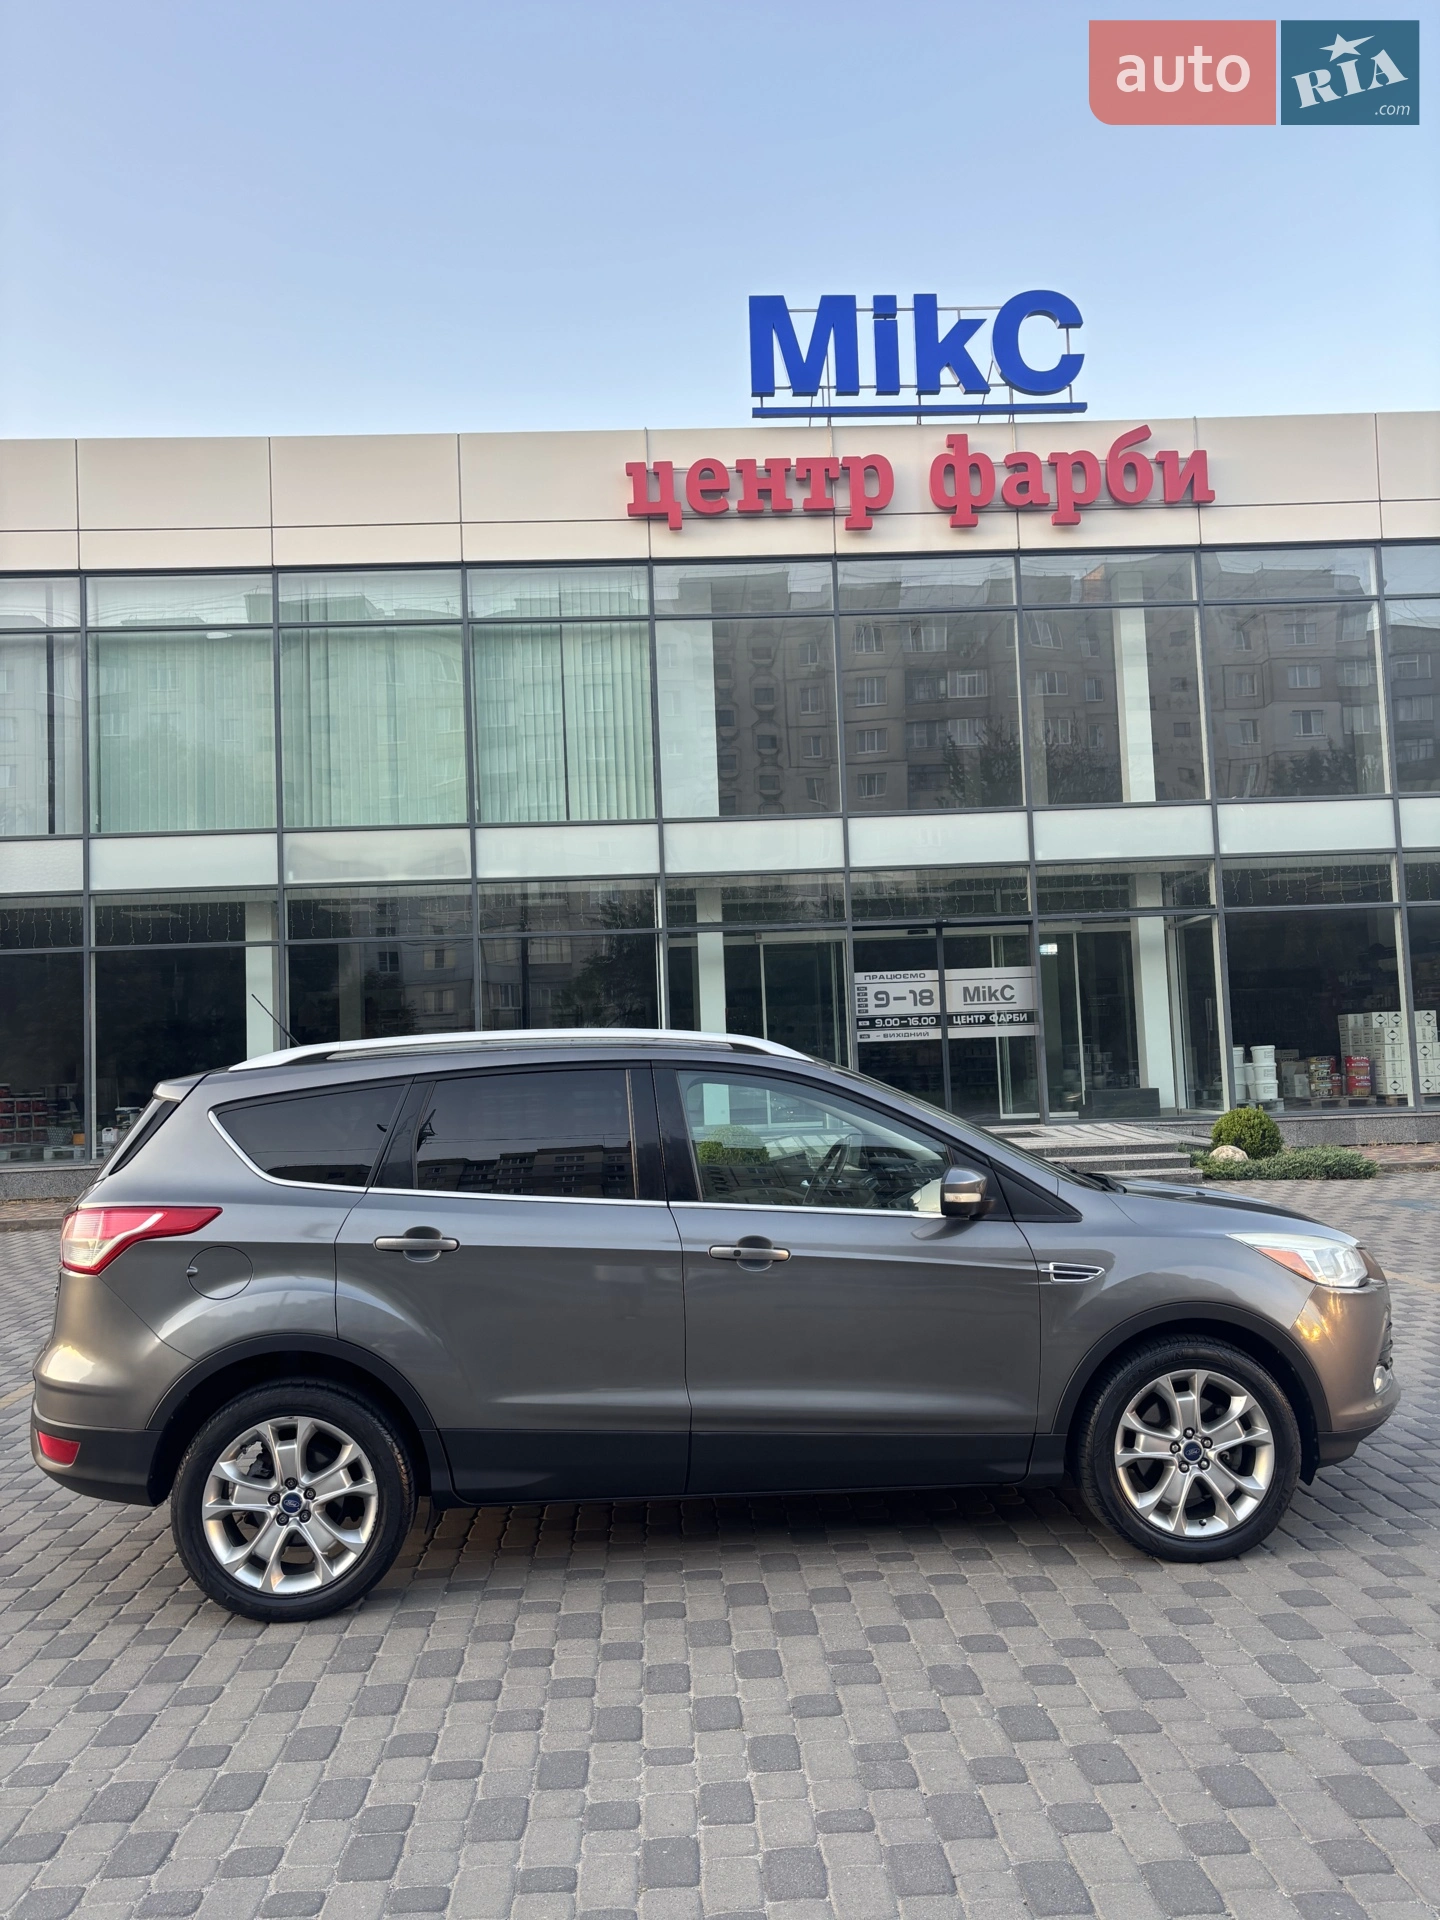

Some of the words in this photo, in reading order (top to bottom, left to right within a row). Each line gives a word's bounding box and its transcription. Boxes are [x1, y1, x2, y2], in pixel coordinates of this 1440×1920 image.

[749, 290, 1085, 397] MikC
[625, 454, 895, 531] центр
[929, 424, 1216, 529] фарби
[864, 972, 926, 980] ПРАЦЮЄМО
[962, 984, 1016, 1002] MikC
[952, 1014, 986, 1025] ЦЕНТР
[989, 1013, 1028, 1023] ФАРБИ
[882, 1031, 930, 1039] ВИХІДНИЙ
